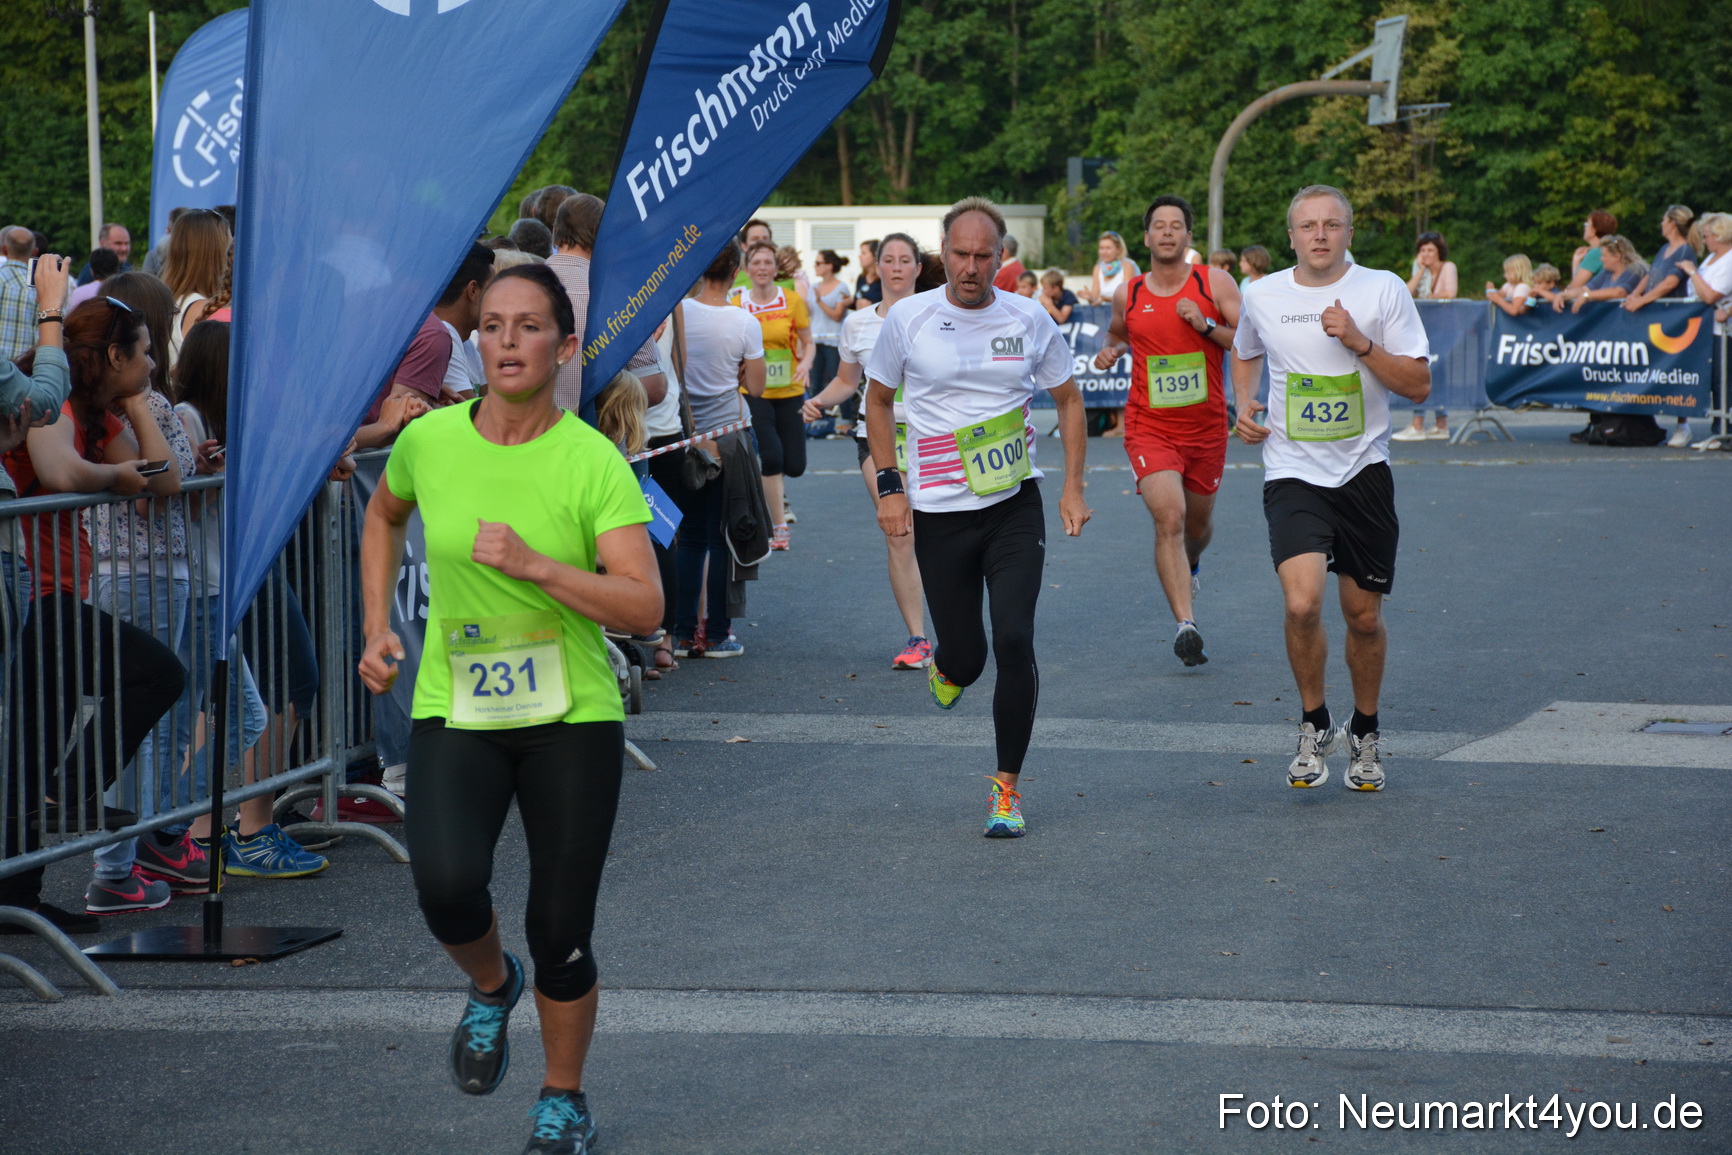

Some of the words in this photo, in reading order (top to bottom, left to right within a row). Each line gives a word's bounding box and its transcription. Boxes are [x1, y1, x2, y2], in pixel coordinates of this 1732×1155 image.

[750, 72, 797, 131] Druck
[794, 40, 826, 80] und
[194, 77, 243, 166] Fisc
[626, 2, 817, 221] Frischmann
[1497, 333, 1650, 366] Frischmann
[1076, 378, 1132, 392] TOMO
[1155, 372, 1199, 393] 1391
[1582, 366, 1622, 382] Druck
[1624, 368, 1649, 383] und
[1648, 369, 1700, 385] Medien
[1301, 401, 1349, 423] 432
[972, 437, 1023, 474] 1000
[469, 656, 537, 697] 231
